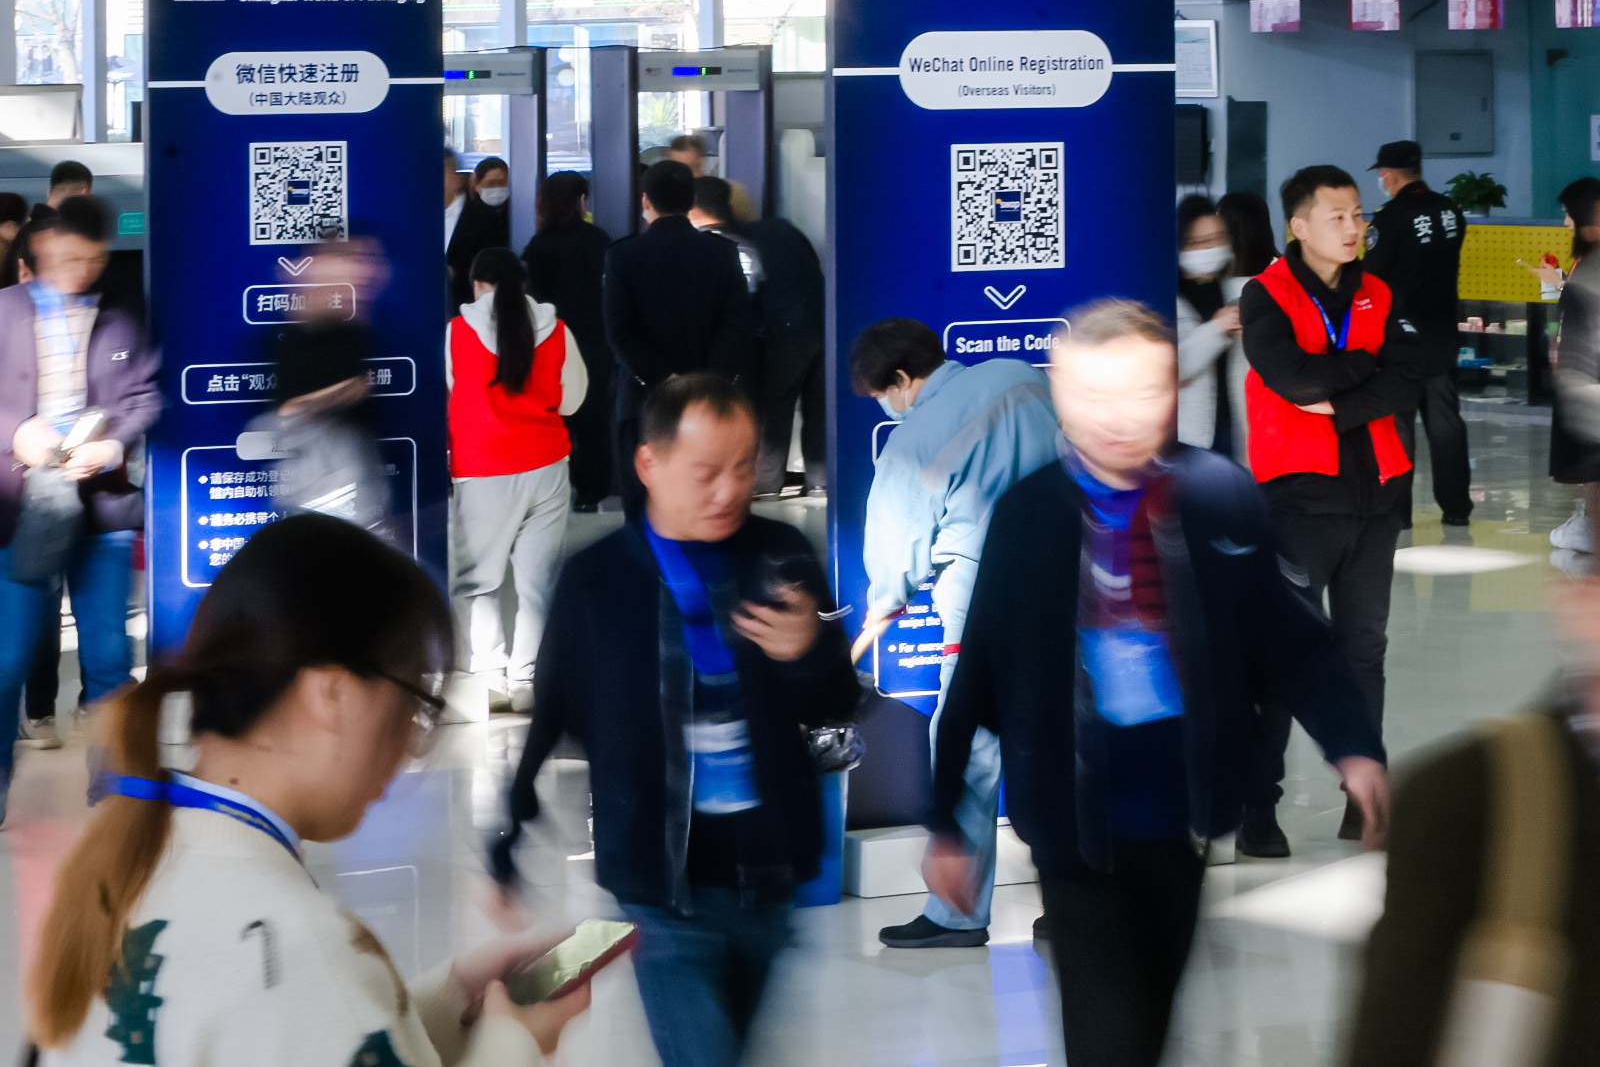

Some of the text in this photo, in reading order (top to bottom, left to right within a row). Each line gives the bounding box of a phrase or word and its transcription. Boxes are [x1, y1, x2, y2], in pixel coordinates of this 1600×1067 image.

[236, 63, 360, 85] 微信快速注册
[908, 55, 1104, 75] WeChat Online Registration
[957, 83, 1056, 97] (Overseas Visitors)
[257, 293, 343, 313] 扫码加注
[955, 334, 1060, 354] Scan the Code
[898, 642, 915, 654] For
